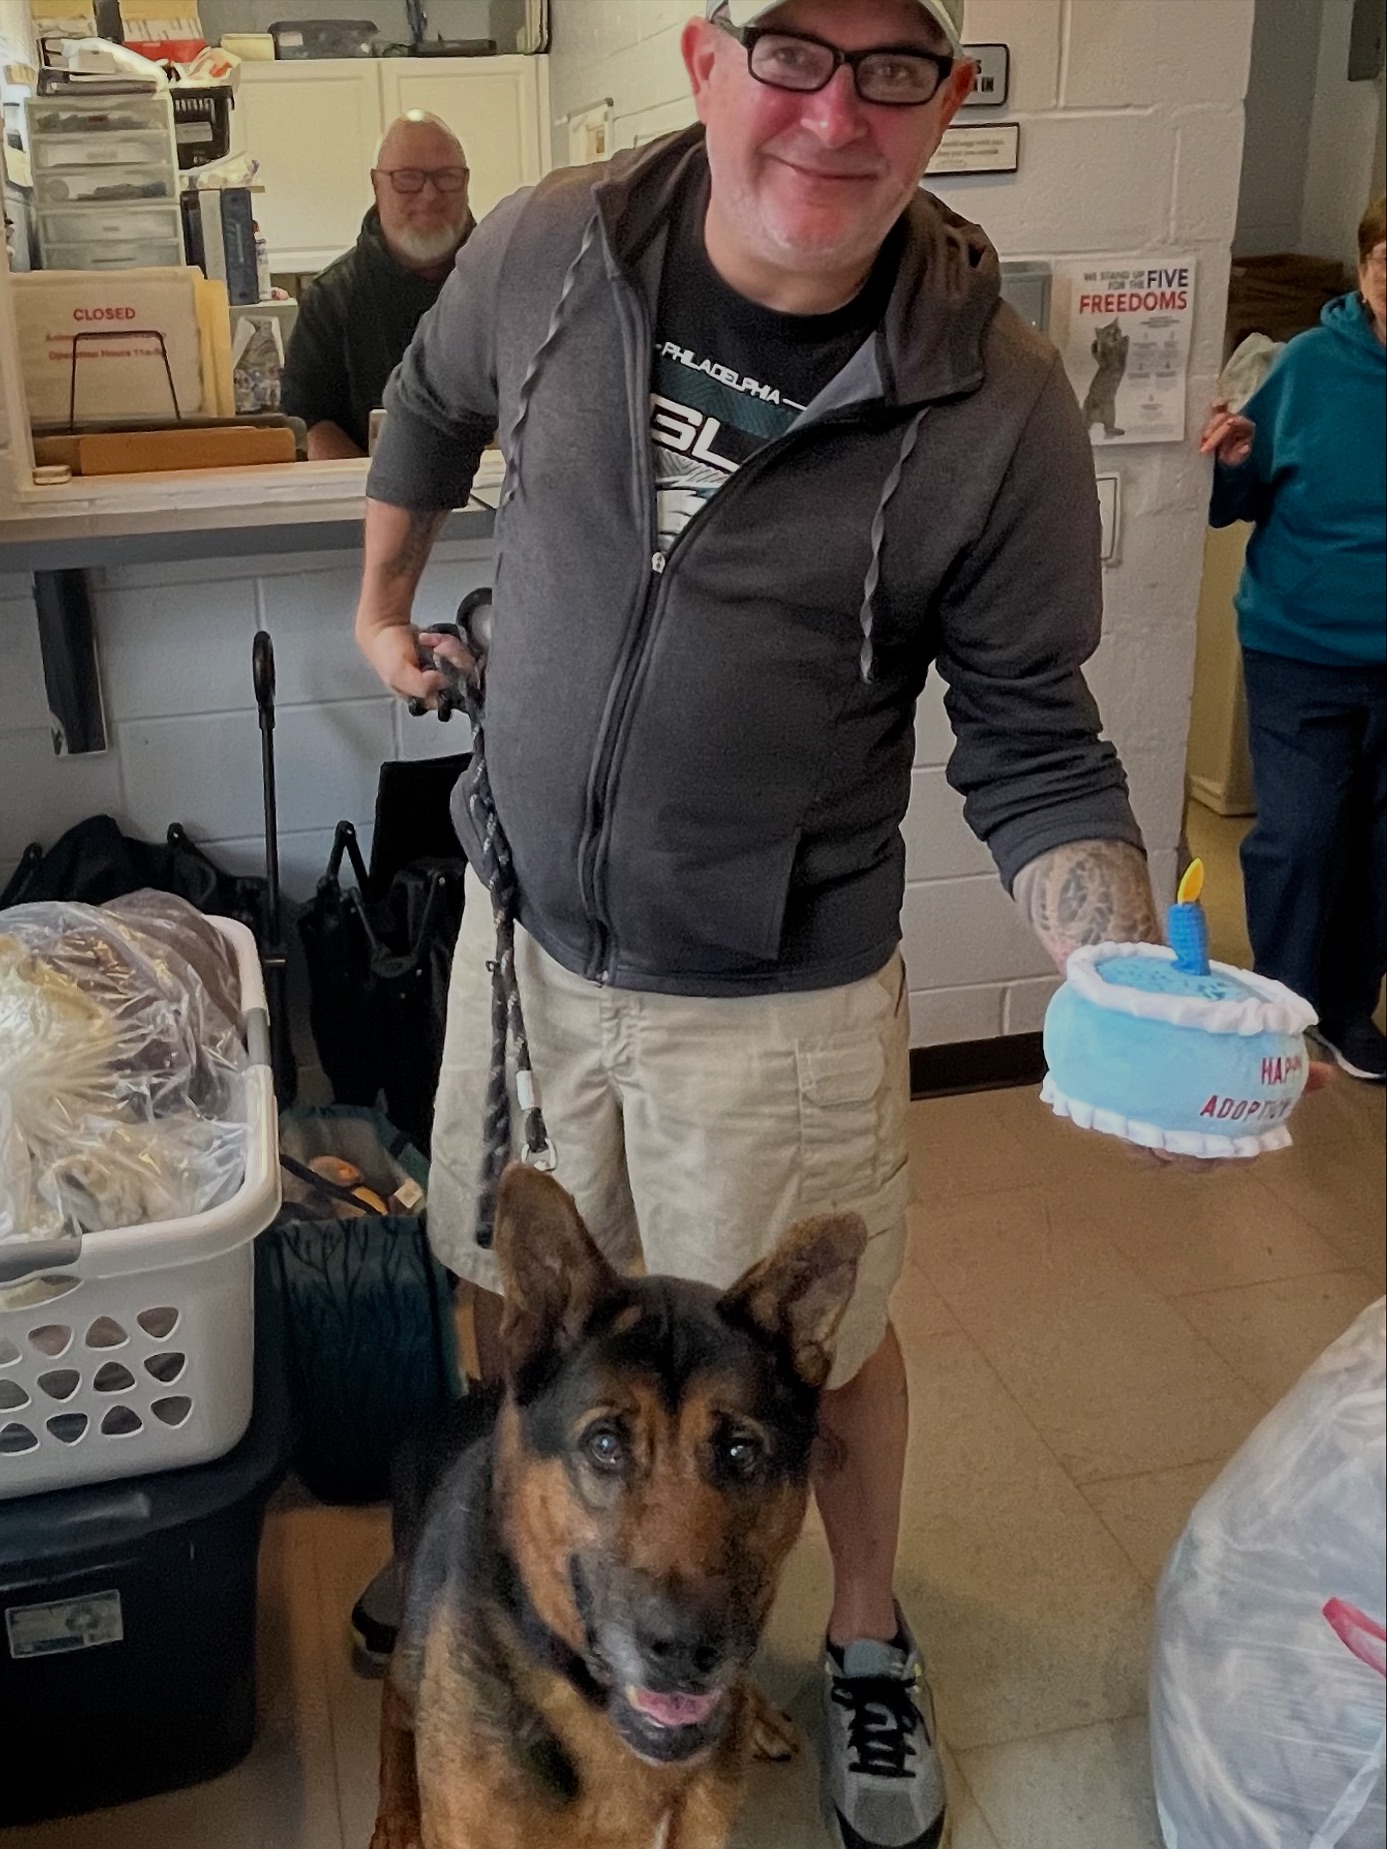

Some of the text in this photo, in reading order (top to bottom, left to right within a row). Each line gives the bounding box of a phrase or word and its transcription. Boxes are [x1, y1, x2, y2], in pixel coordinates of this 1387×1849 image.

[1147, 268, 1189, 289] FIVE
[1079, 290, 1188, 314] FREEDOMS
[73, 307, 136, 321] CLOSED
[661, 341, 781, 405] PHILADELPHIA
